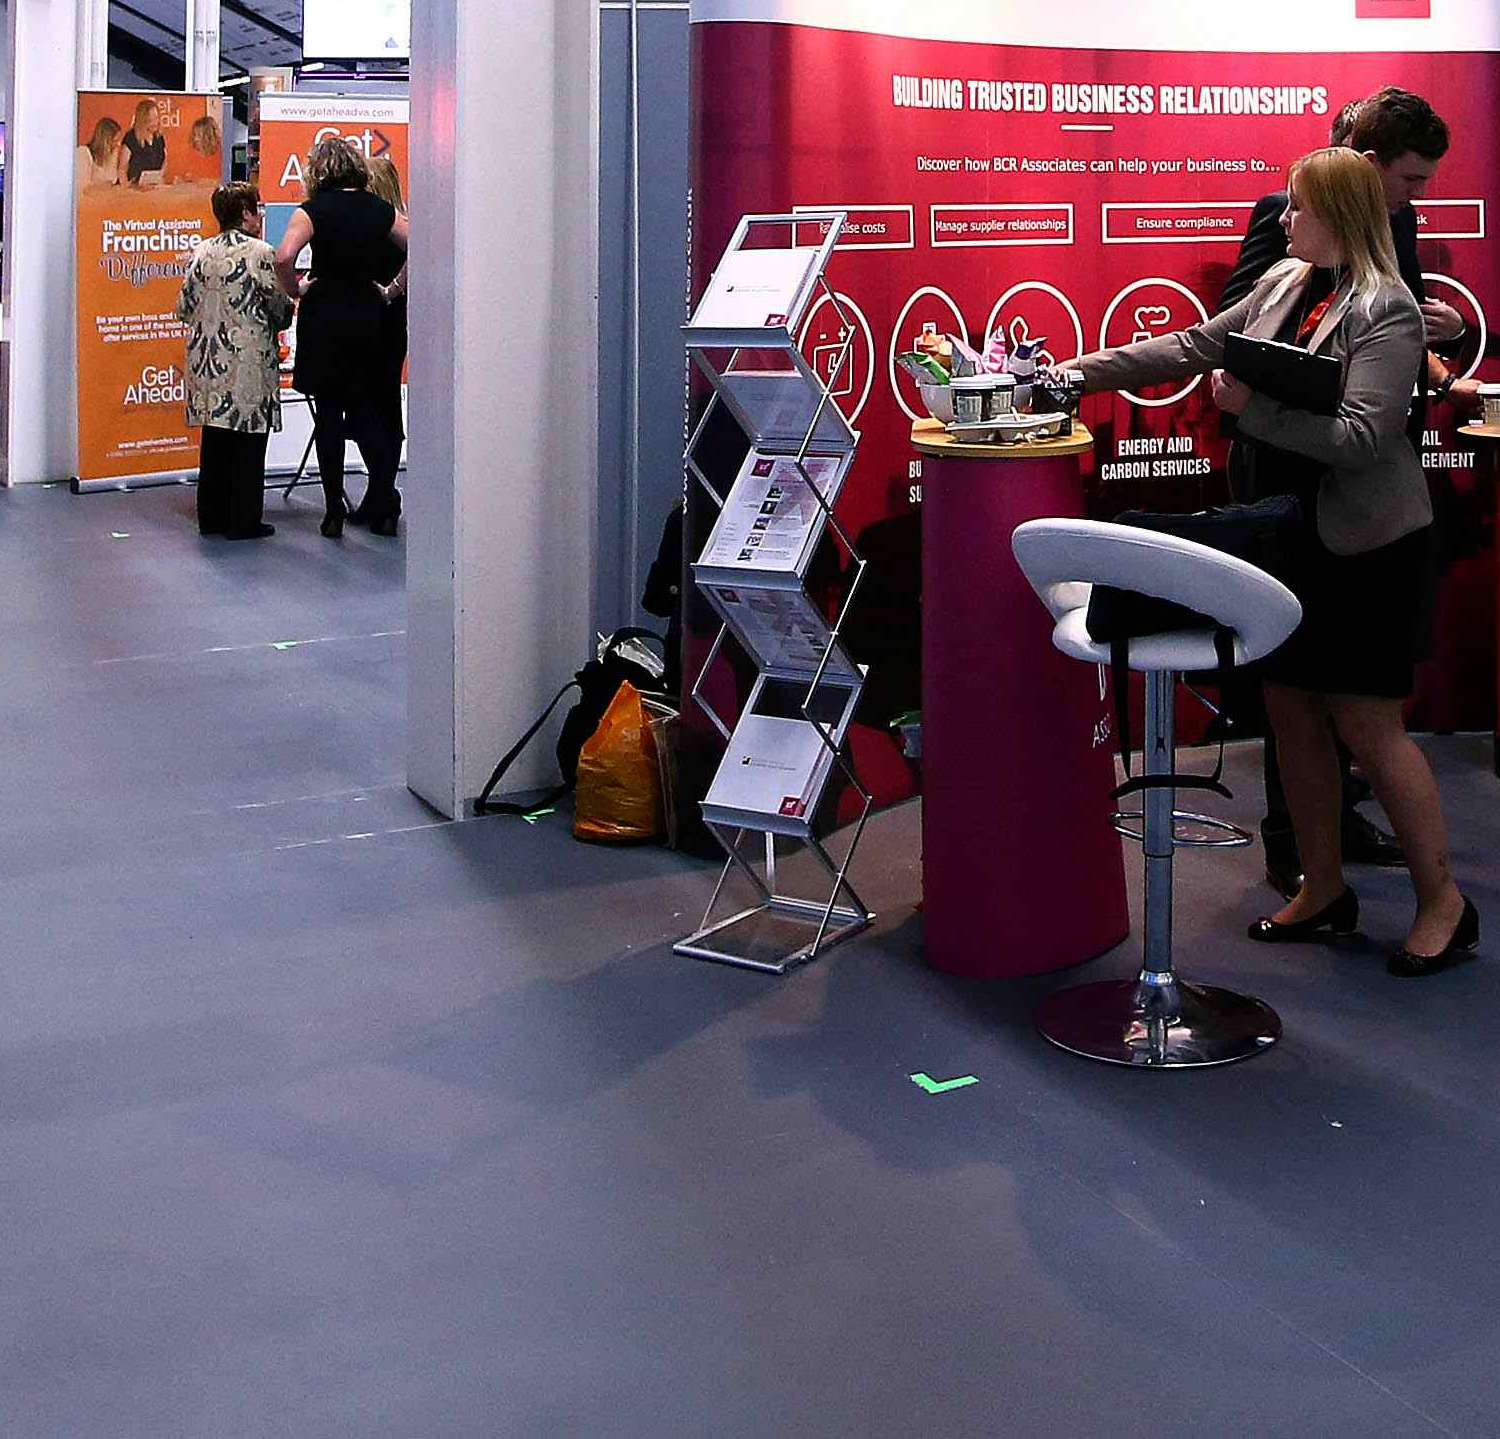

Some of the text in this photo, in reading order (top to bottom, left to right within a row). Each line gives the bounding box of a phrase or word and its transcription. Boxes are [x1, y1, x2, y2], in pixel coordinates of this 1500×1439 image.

[892, 75, 1329, 115] BUILDING TRUSTED BUSINESS RELATIONSHIPS
[917, 155, 1281, 175] Discover how BCR Associates can help your business to...
[103, 219, 201, 231] The Virtual Assistant
[861, 221, 886, 234] costs
[935, 217, 1067, 235] Manage supplier relationships
[1136, 216, 1234, 231] Ensure compliance
[102, 230, 202, 253] Franchise
[98, 324, 120, 333] home
[129, 324, 143, 332] one
[107, 315, 124, 326] your
[124, 316, 141, 324] own
[141, 314, 158, 323] boss
[158, 313, 173, 322] and
[122, 332, 150, 342] services
[170, 329, 183, 339] UK
[142, 366, 175, 387] Get
[124, 380, 185, 406] Ahead
[1118, 436, 1193, 456] ENERGY AND
[1101, 457, 1211, 480] CARBON SERVICES
